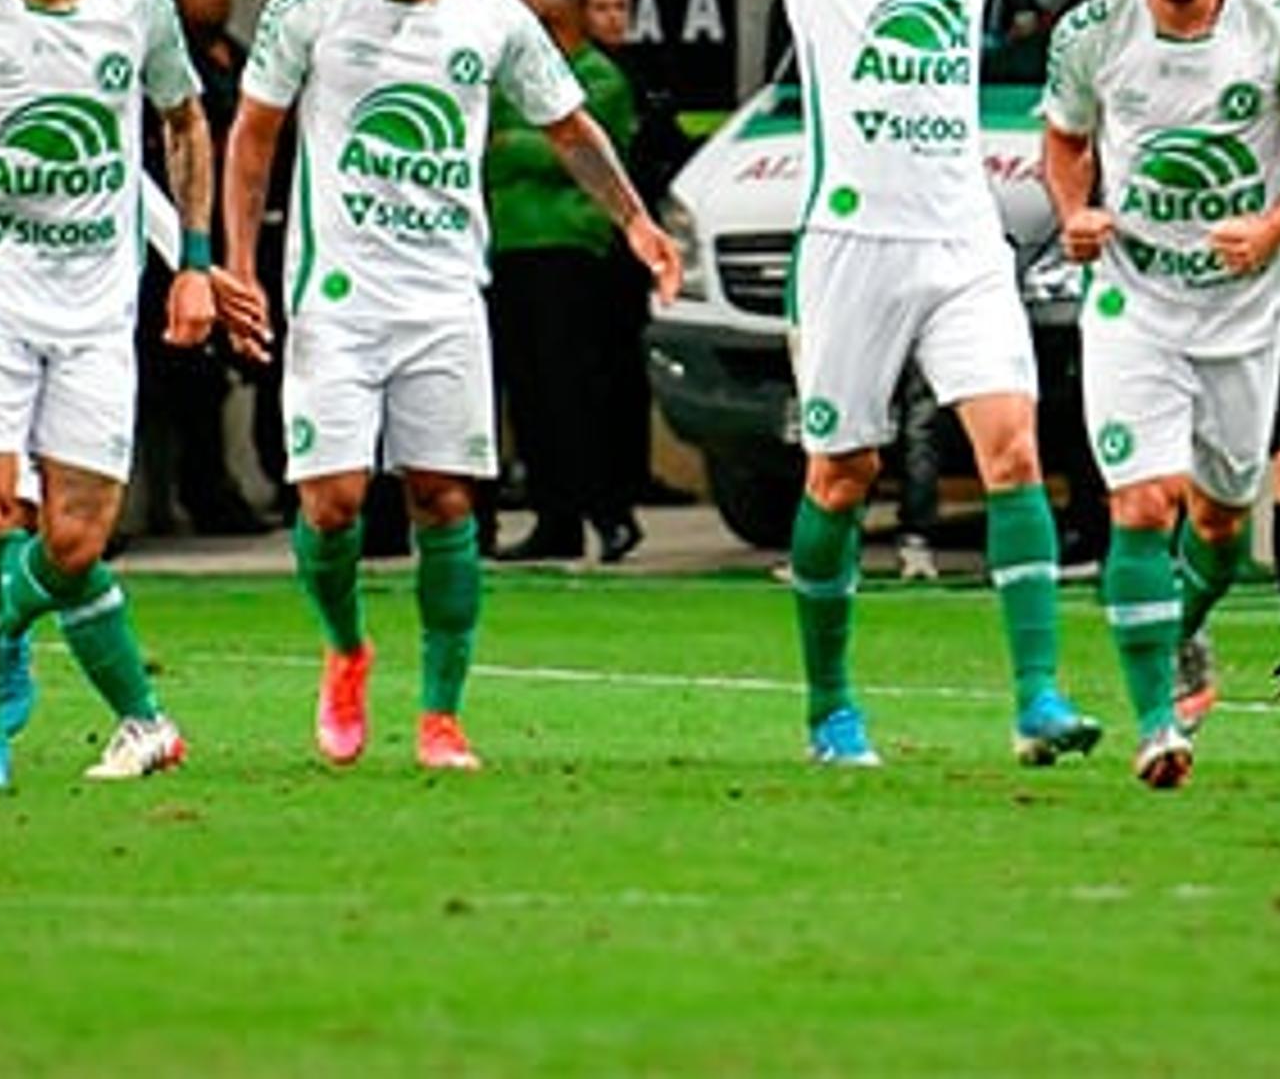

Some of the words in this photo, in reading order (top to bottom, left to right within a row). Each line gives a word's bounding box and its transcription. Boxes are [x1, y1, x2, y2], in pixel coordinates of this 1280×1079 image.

[851, 45, 970, 85] Auroa
[338, 138, 470, 189] Aurora
[1121, 183, 1265, 220] Aurora
